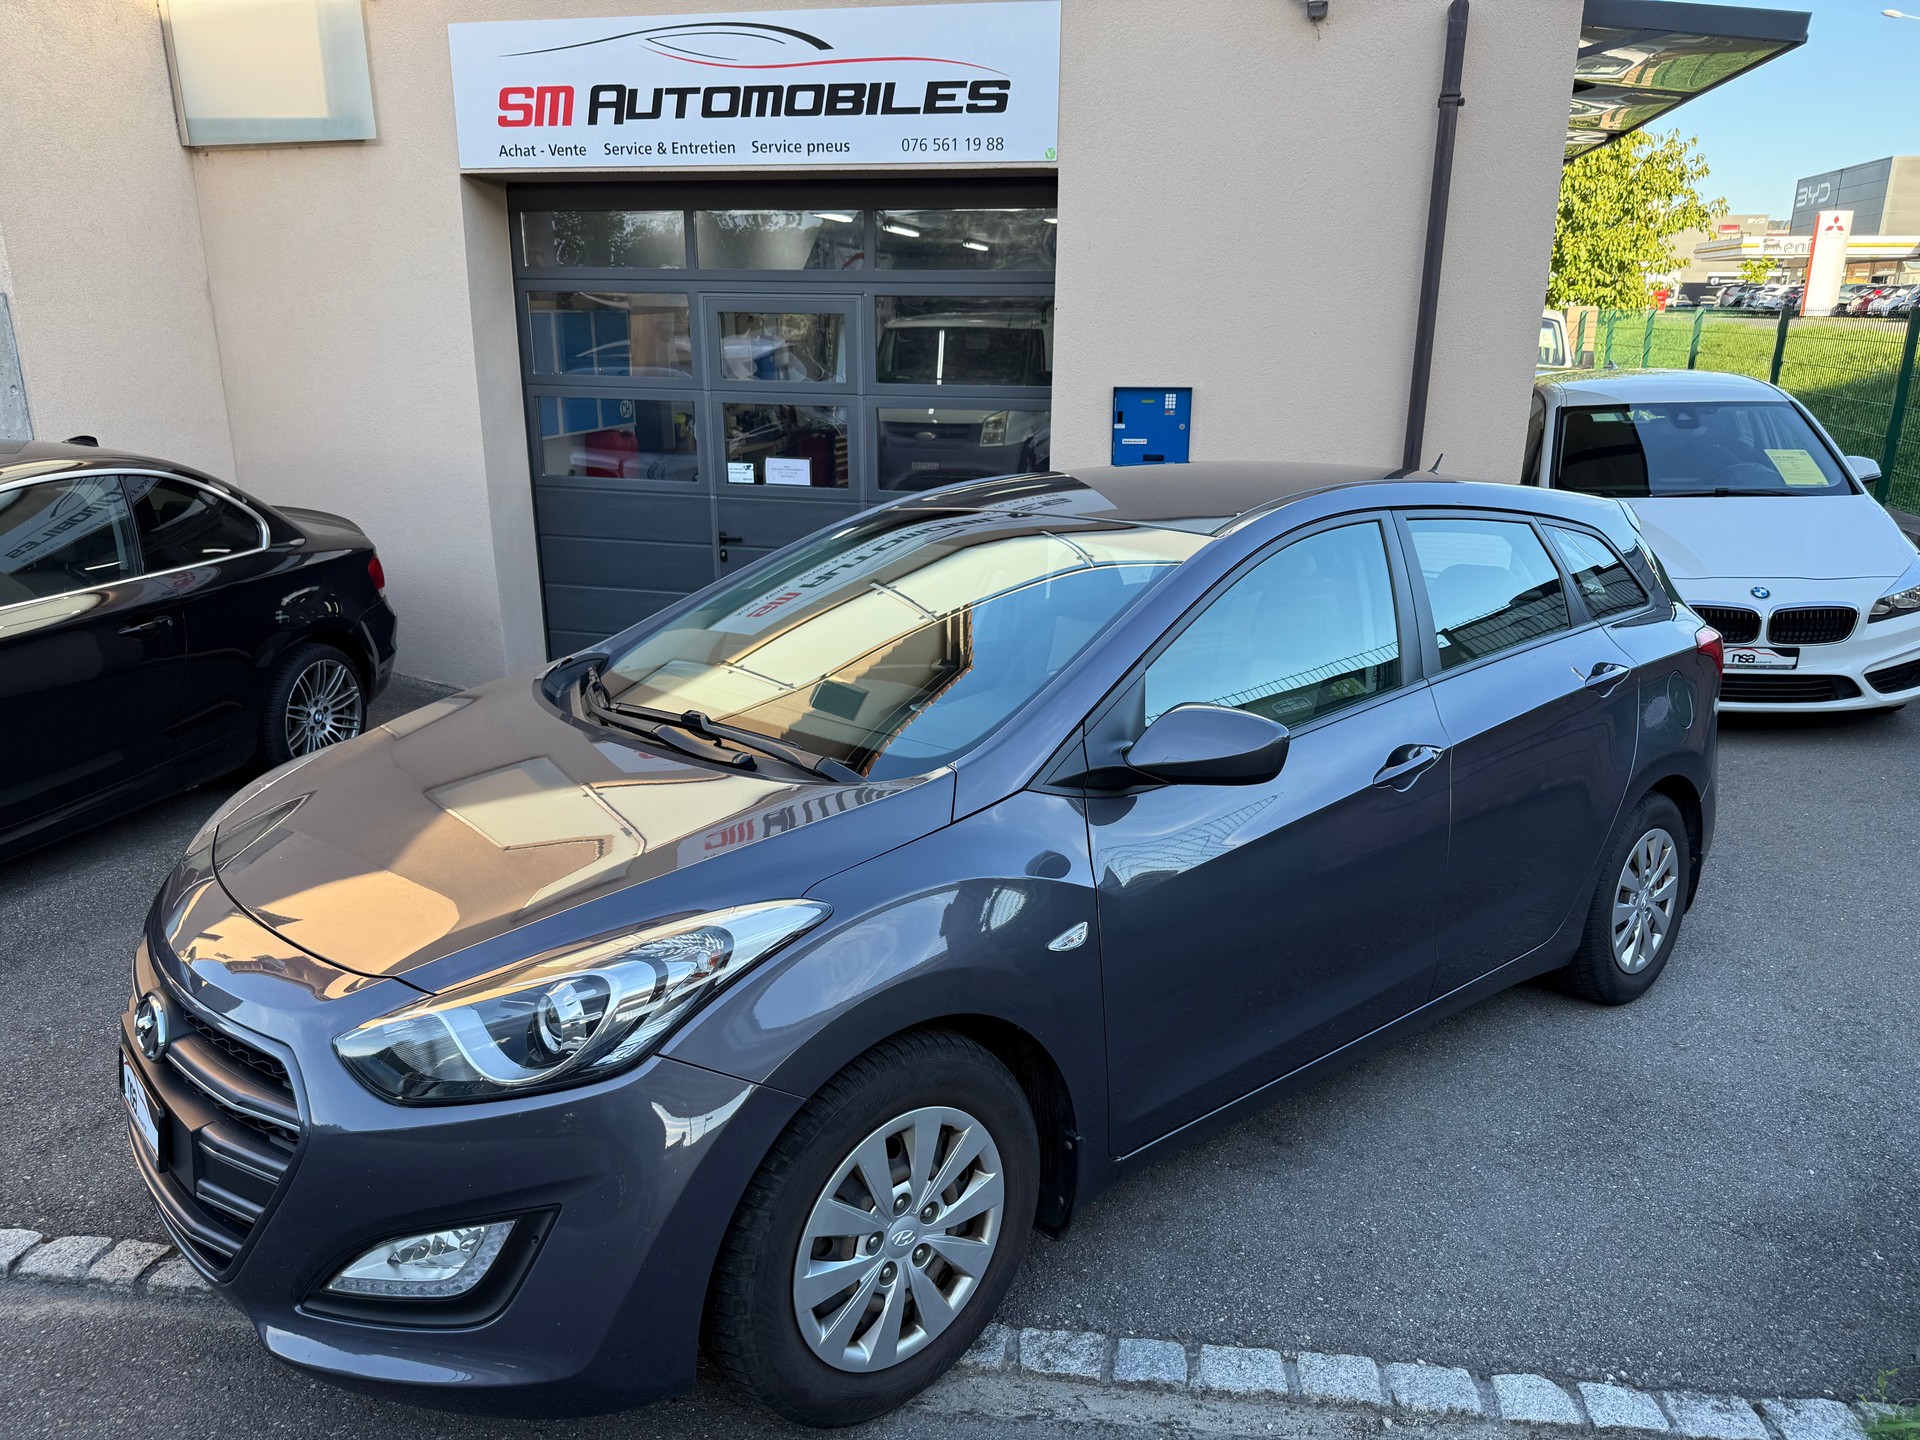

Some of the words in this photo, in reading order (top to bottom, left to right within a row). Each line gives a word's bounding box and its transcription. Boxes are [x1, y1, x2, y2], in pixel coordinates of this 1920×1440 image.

[497, 85, 575, 128] SM
[498, 143, 537, 158] Achat
[547, 142, 587, 157] Vente
[603, 141, 653, 157] Service
[656, 141, 667, 155] &
[671, 140, 737, 156] Entretien
[751, 139, 803, 155] Service
[806, 142, 851, 157] pneus
[901, 137, 929, 153] 076
[932, 137, 959, 153] 561
[964, 136, 983, 152] 19
[985, 136, 1005, 152] 88
[1796, 182, 1831, 208] BYD
[1731, 653, 1756, 664] nsa
